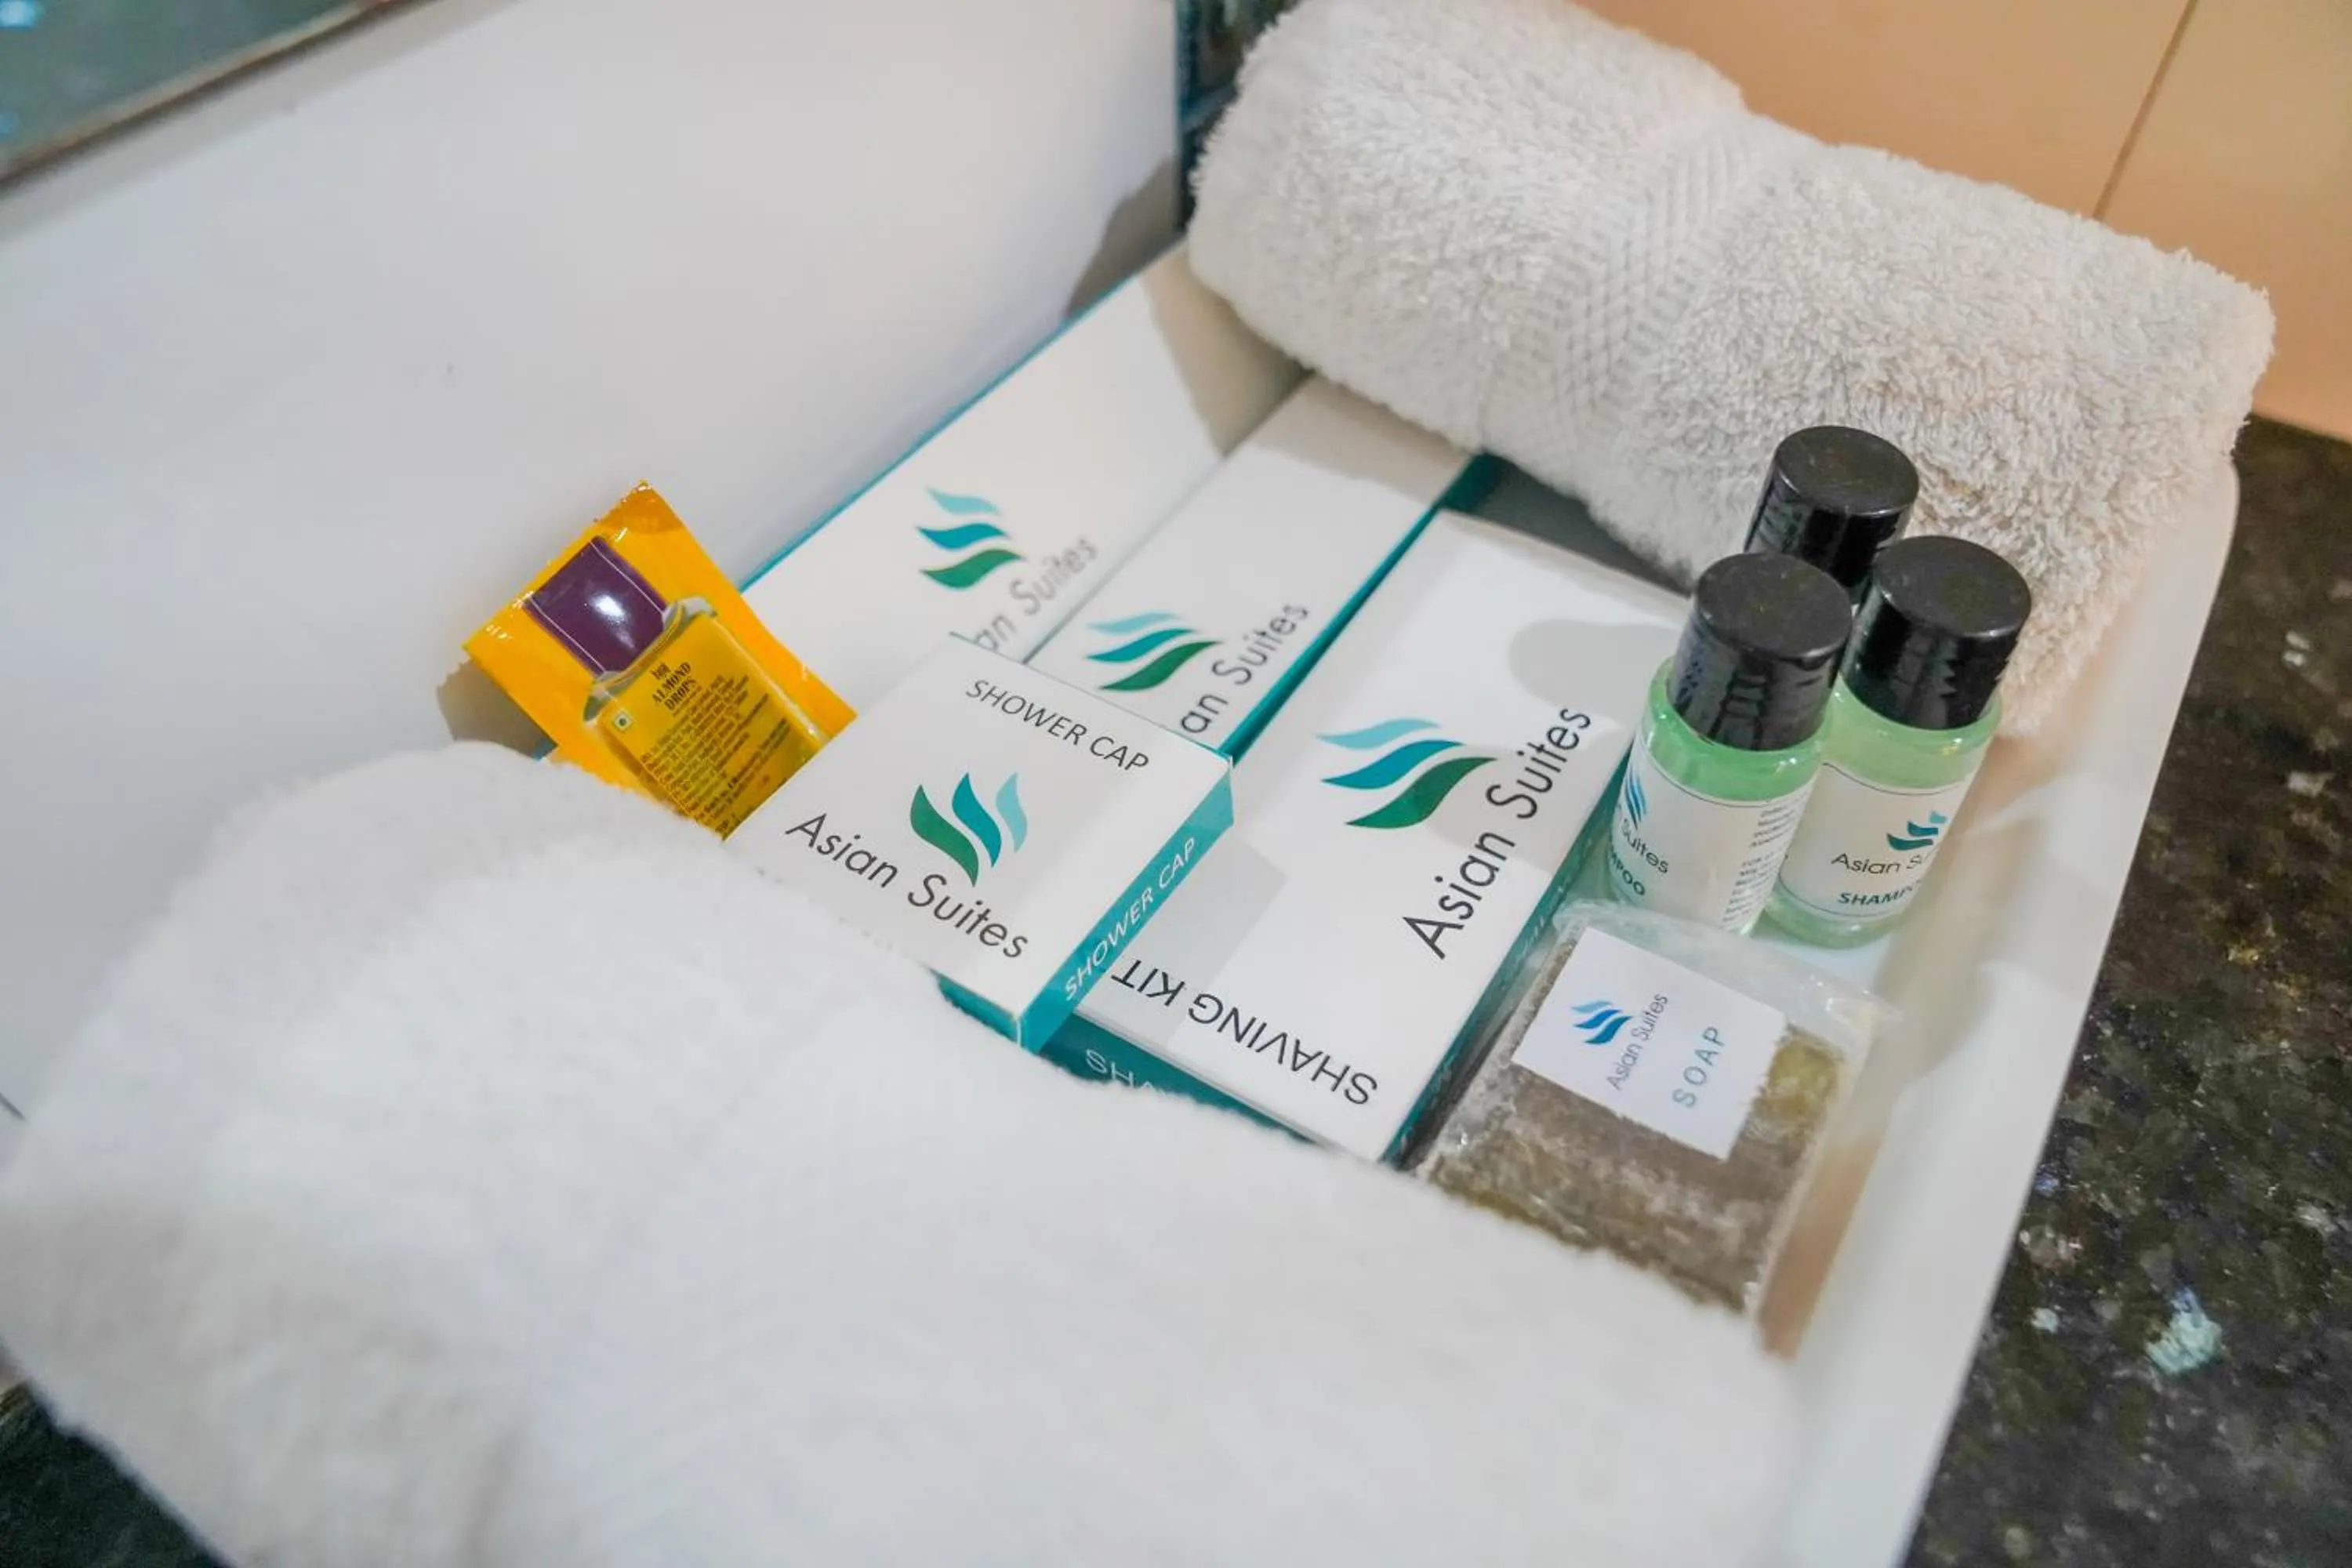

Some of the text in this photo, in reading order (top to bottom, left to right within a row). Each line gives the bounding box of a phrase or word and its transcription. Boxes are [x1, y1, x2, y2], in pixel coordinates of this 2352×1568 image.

[652, 662, 691, 703] ALMOND
[1212, 603, 1309, 684] Suites
[966, 679, 1150, 772] SHOWER CAP
[1402, 707, 1591, 960] Asian Suites
[1831, 852, 1901, 874] Asian
[785, 812, 1029, 959] Asian Suites
[1064, 887, 1156, 1002] SHOWER
[1157, 837, 1196, 890] CAP
[1110, 959, 1187, 1007] KIT
[1187, 992, 1378, 1105] SHAVING
[1607, 993, 1670, 1091] Asian Suites
[1671, 1025, 1726, 1109] SOAP
